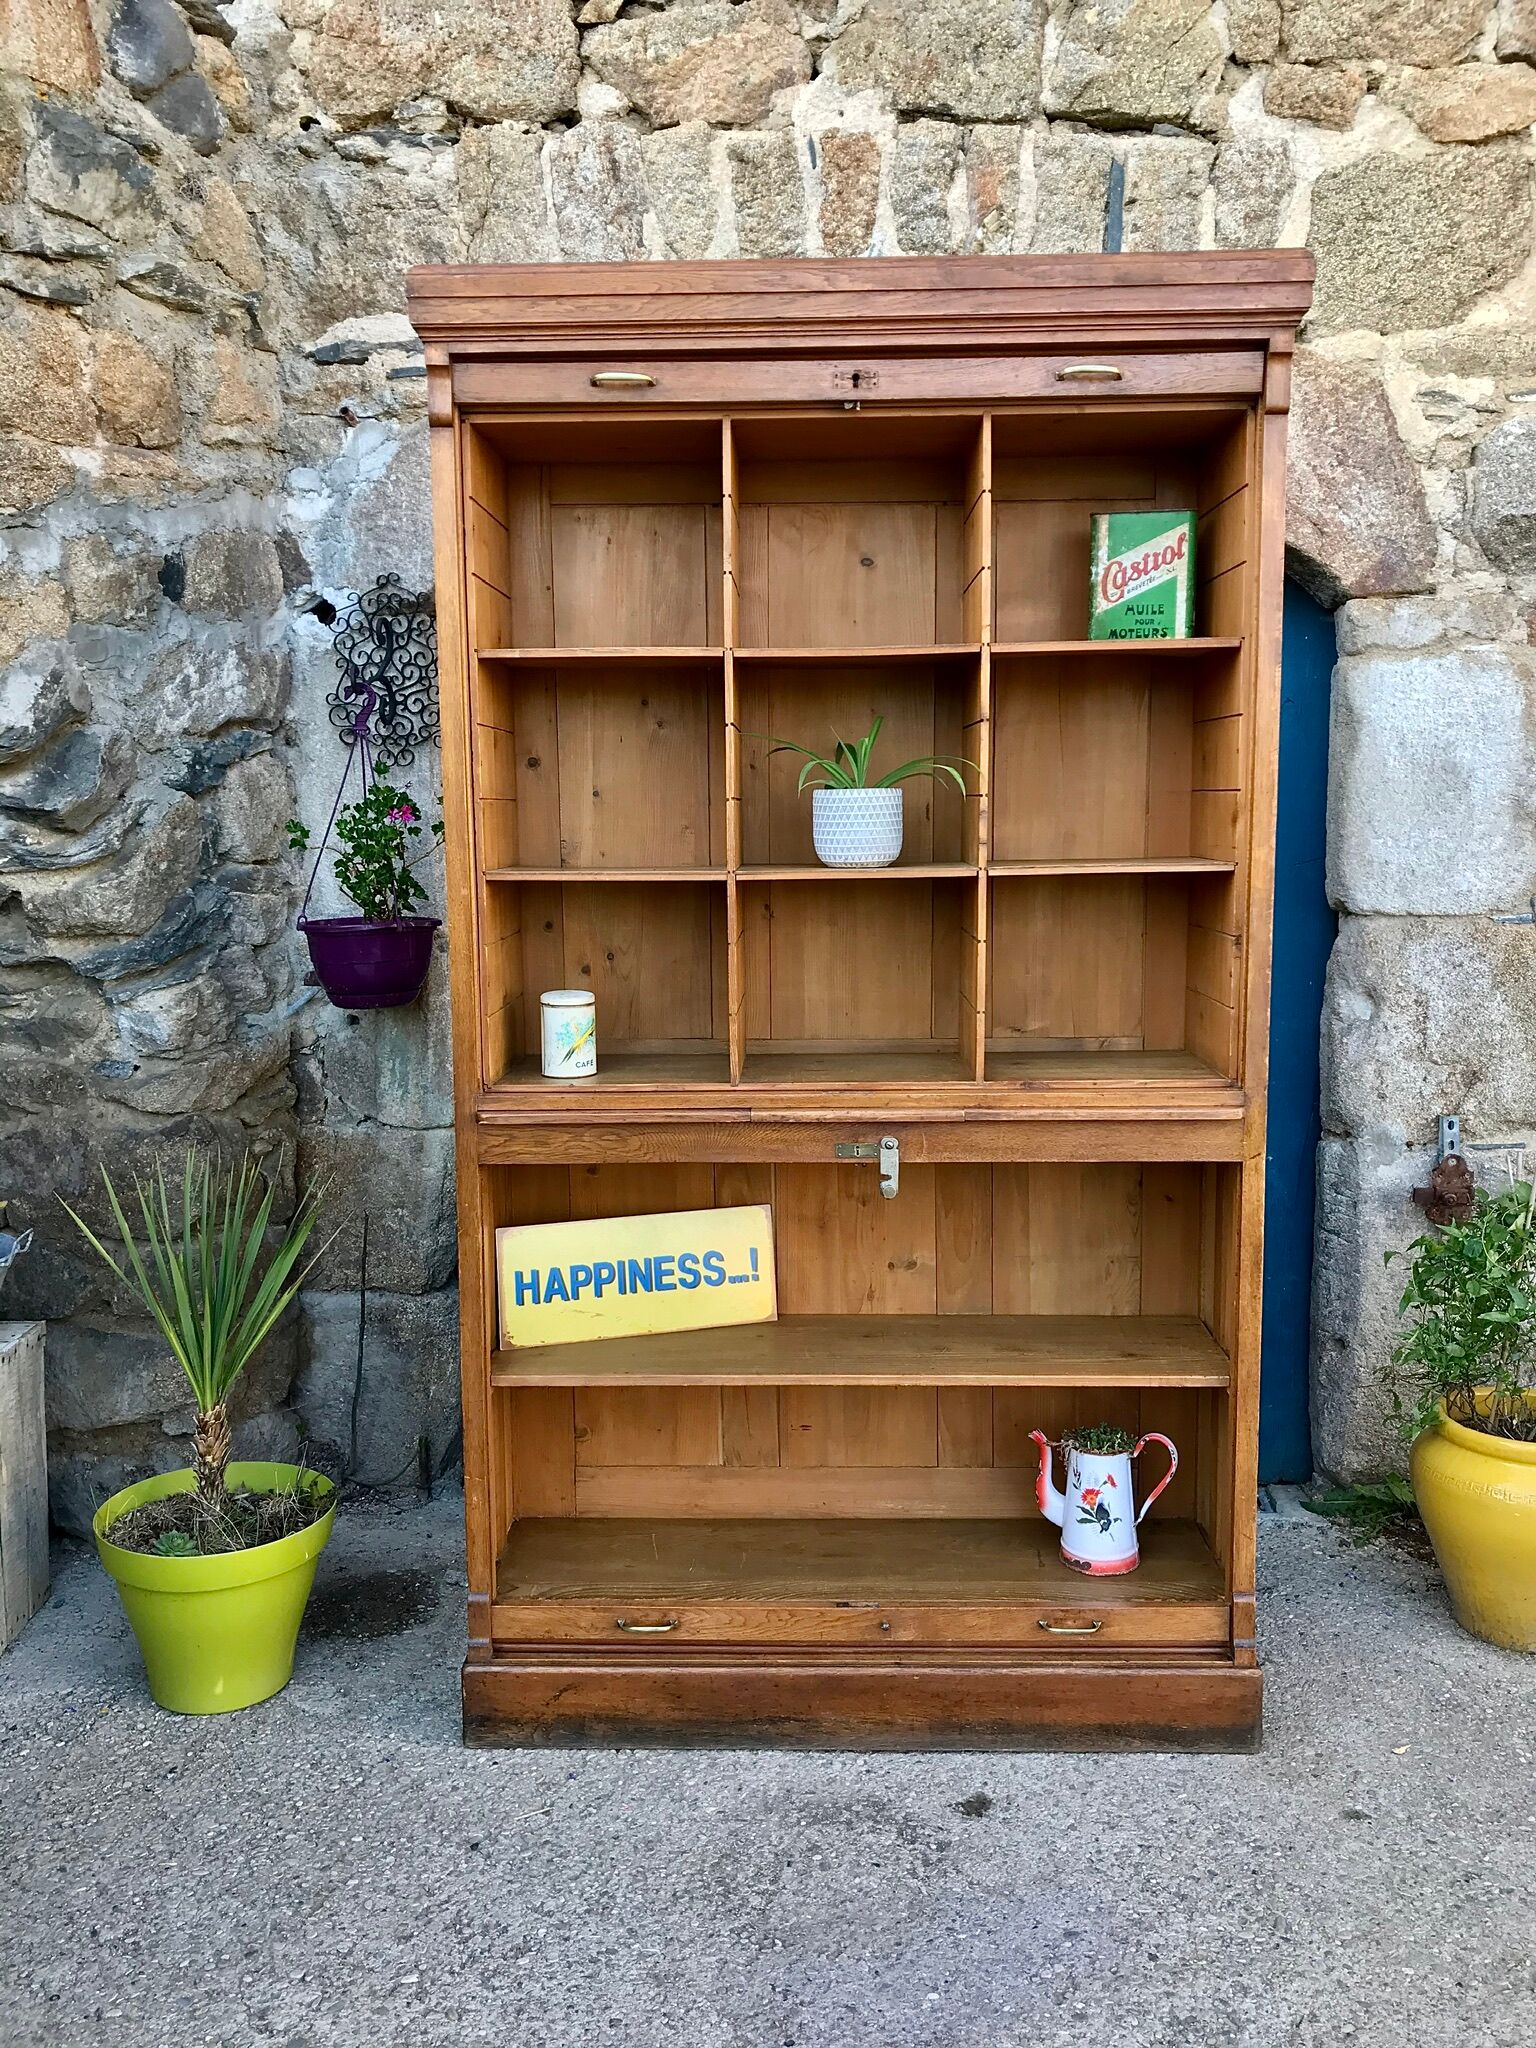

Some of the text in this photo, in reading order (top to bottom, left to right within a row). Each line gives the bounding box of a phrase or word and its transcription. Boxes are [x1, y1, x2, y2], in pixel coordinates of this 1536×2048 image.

[1101, 531, 1187, 603] Castrol
[1124, 604, 1165, 616] HUILE
[1107, 627, 1168, 640] MOTEURS
